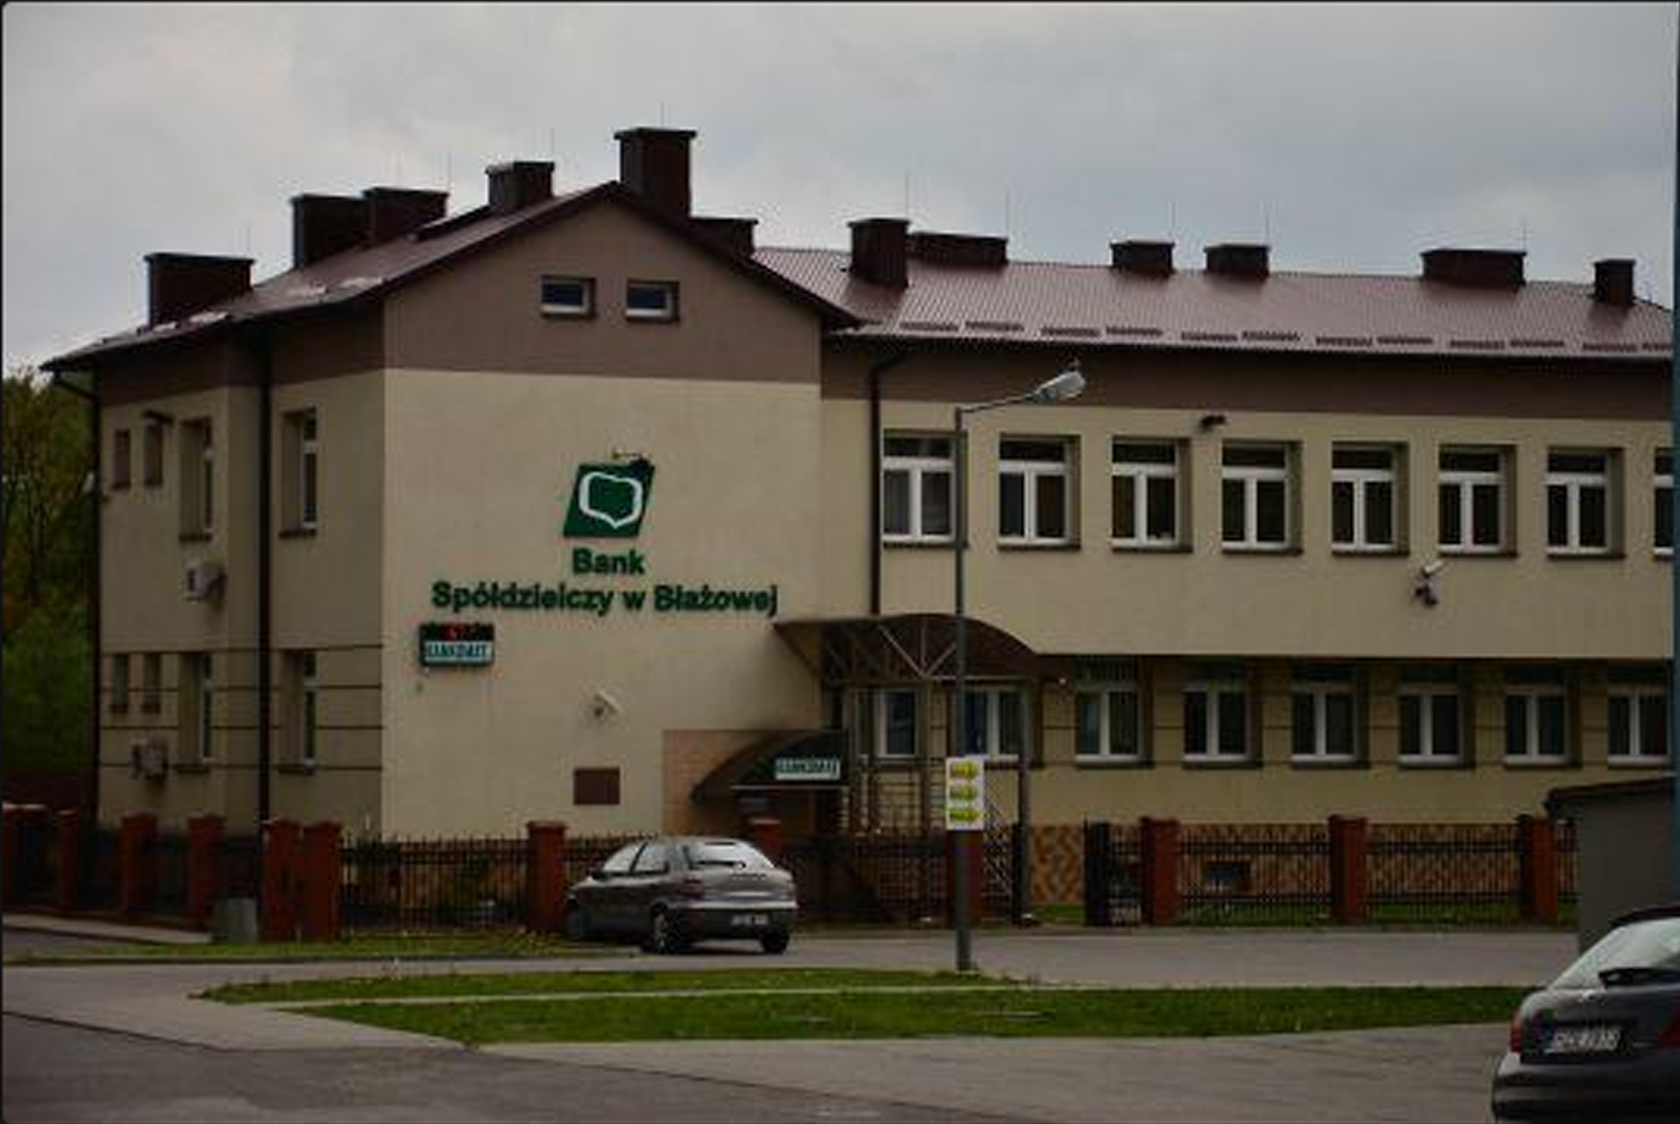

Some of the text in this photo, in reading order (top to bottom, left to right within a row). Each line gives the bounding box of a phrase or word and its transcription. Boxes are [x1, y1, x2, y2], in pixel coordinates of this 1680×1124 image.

[572, 547, 646, 575] Bank
[431, 581, 778, 617] Spółdzielczy w Błażowej
